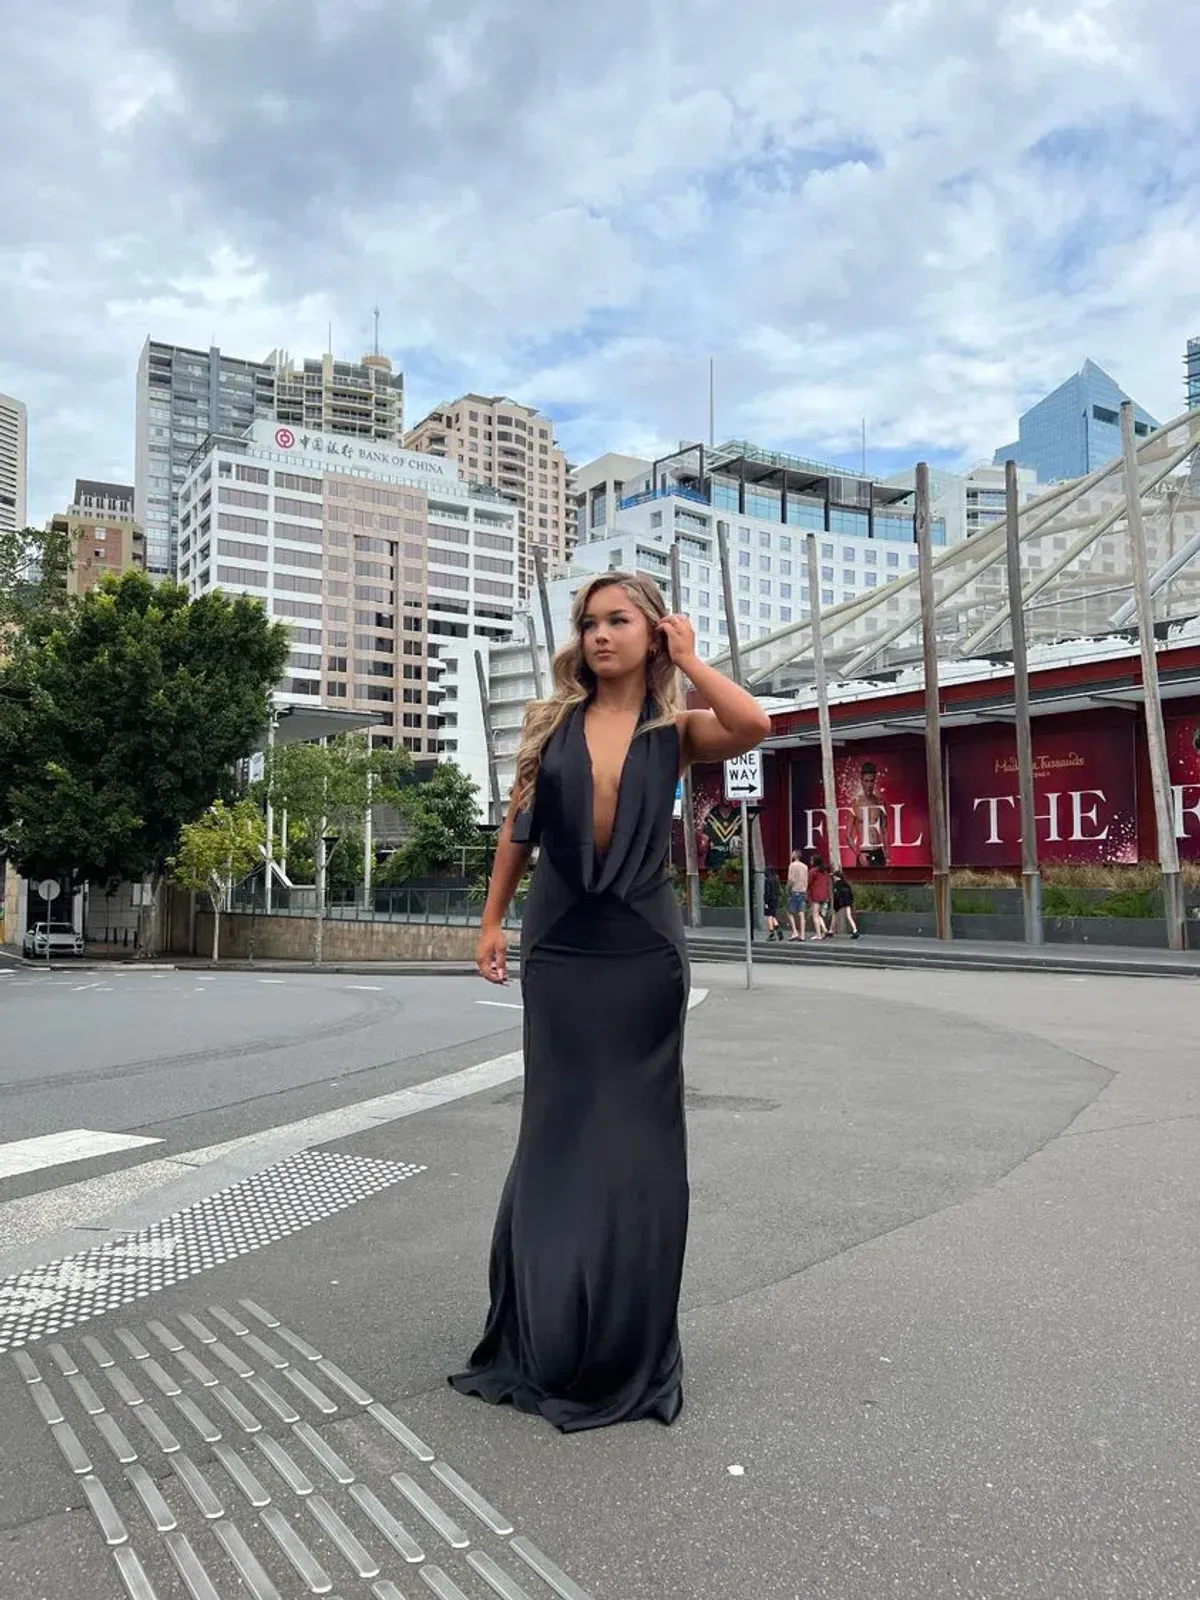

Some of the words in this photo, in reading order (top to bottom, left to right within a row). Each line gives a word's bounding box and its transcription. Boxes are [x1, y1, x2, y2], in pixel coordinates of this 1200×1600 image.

[359, 448, 389, 463] BANK
[391, 455, 405, 467] OF
[408, 459, 444, 475] CHINA
[1036, 752, 1085, 769] Tussauds
[729, 768, 758, 780] WAY
